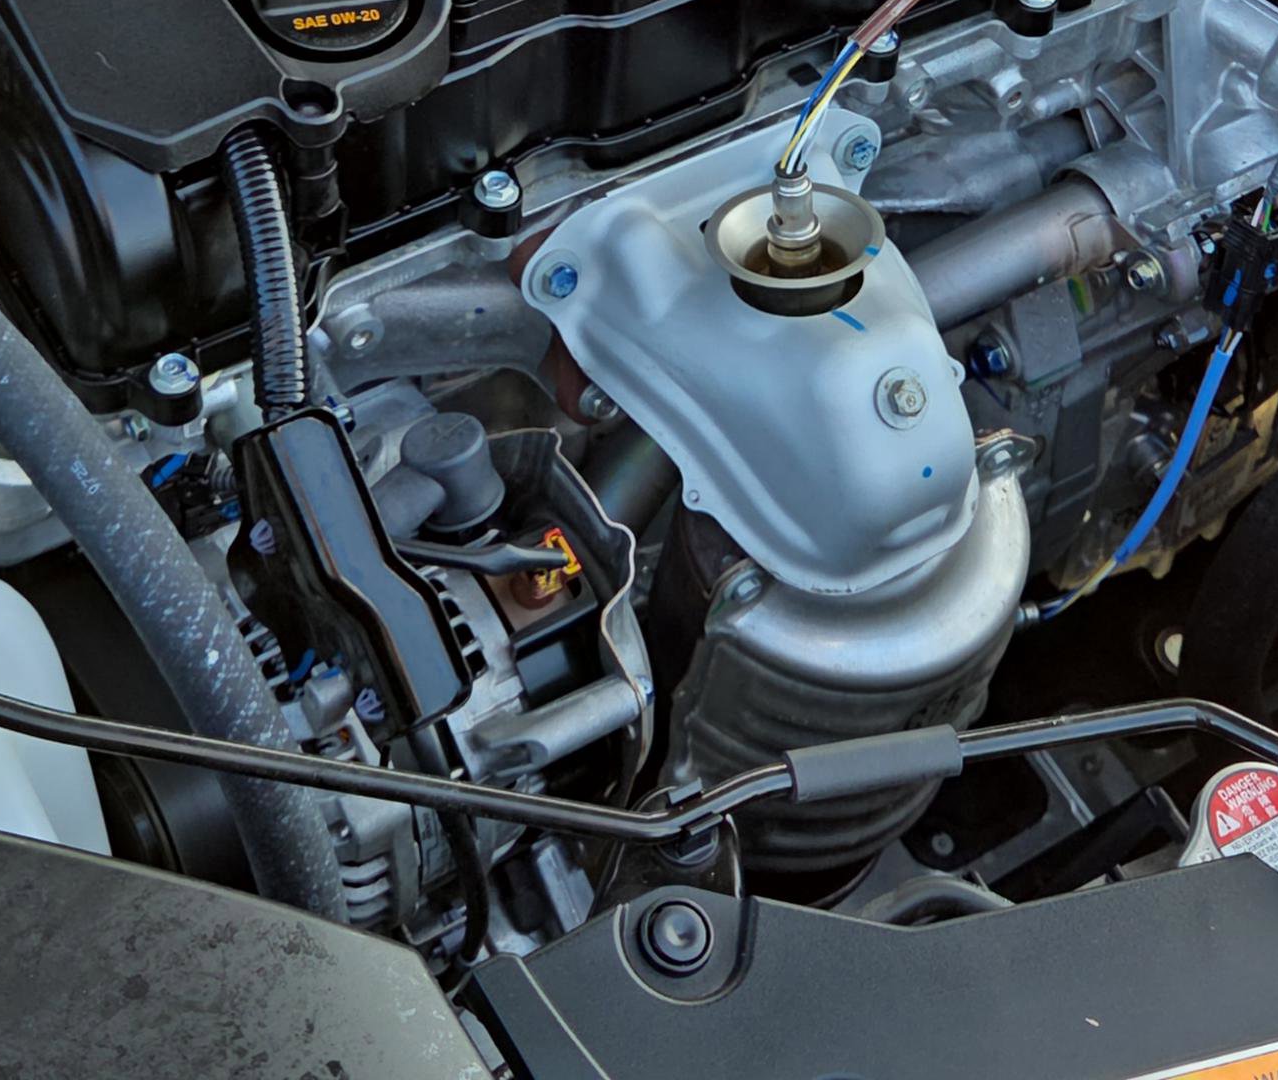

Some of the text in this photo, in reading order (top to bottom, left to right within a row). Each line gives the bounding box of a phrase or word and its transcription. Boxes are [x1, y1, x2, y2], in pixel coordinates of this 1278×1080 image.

[293, 9, 381, 30] SAE 0W-20
[1217, 771, 1261, 800] DANGER
[1224, 776, 1278, 811] WARNUNG
